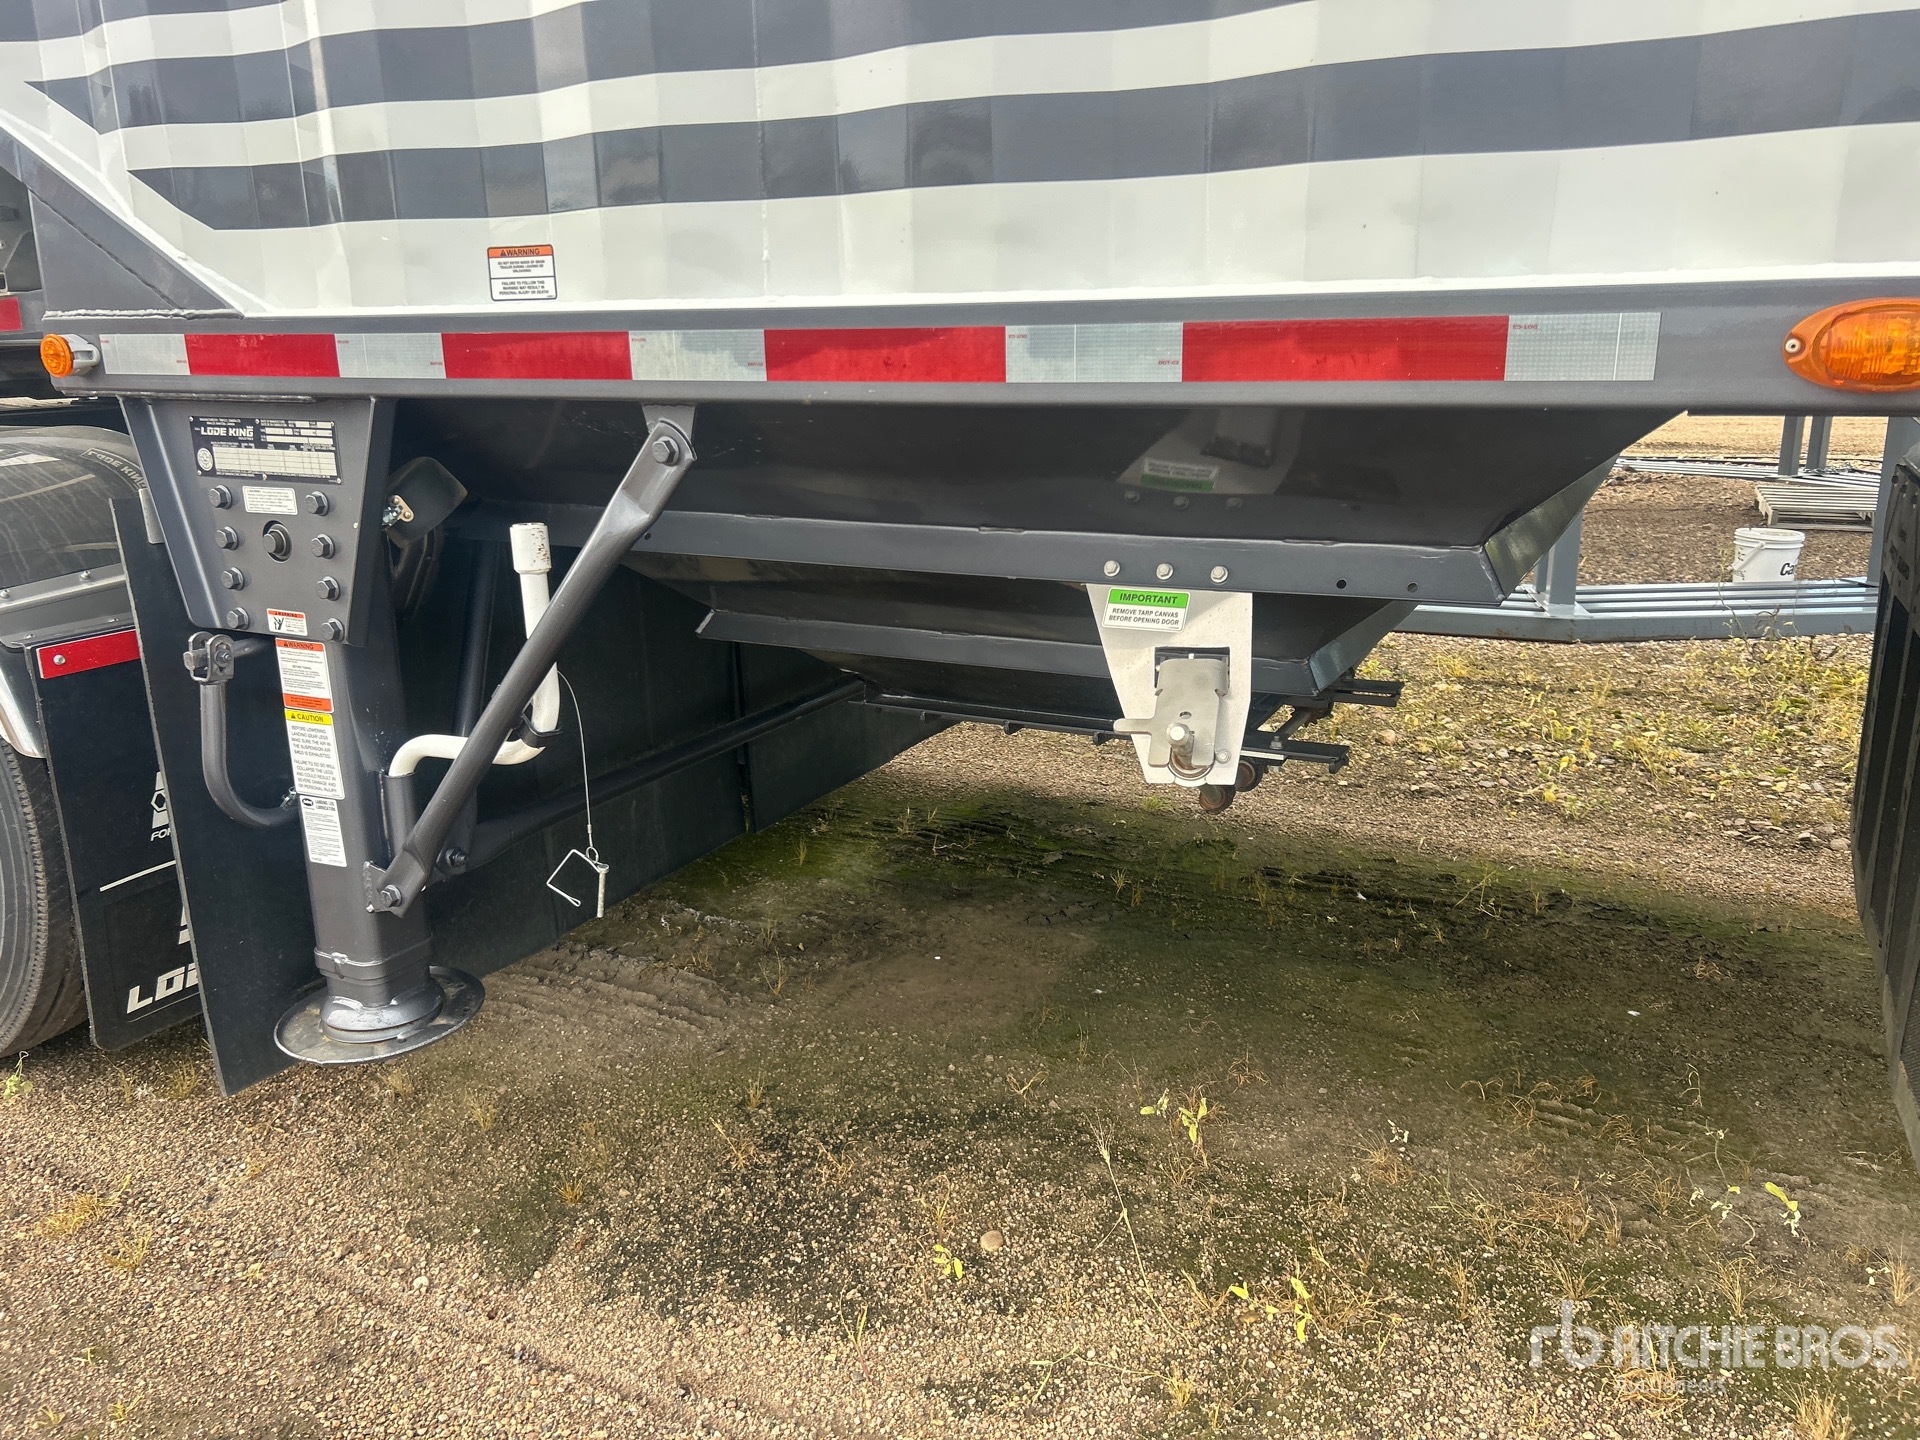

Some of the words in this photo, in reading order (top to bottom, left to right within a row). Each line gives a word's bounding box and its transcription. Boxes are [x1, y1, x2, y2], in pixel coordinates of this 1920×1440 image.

[200, 426, 227, 436] LODE
[228, 426, 254, 436] KING
[88, 450, 123, 468] LODE
[1120, 593, 1178, 604] IMPORTANT
[288, 642, 314, 650] WARNING
[297, 714, 324, 722] CAUTION
